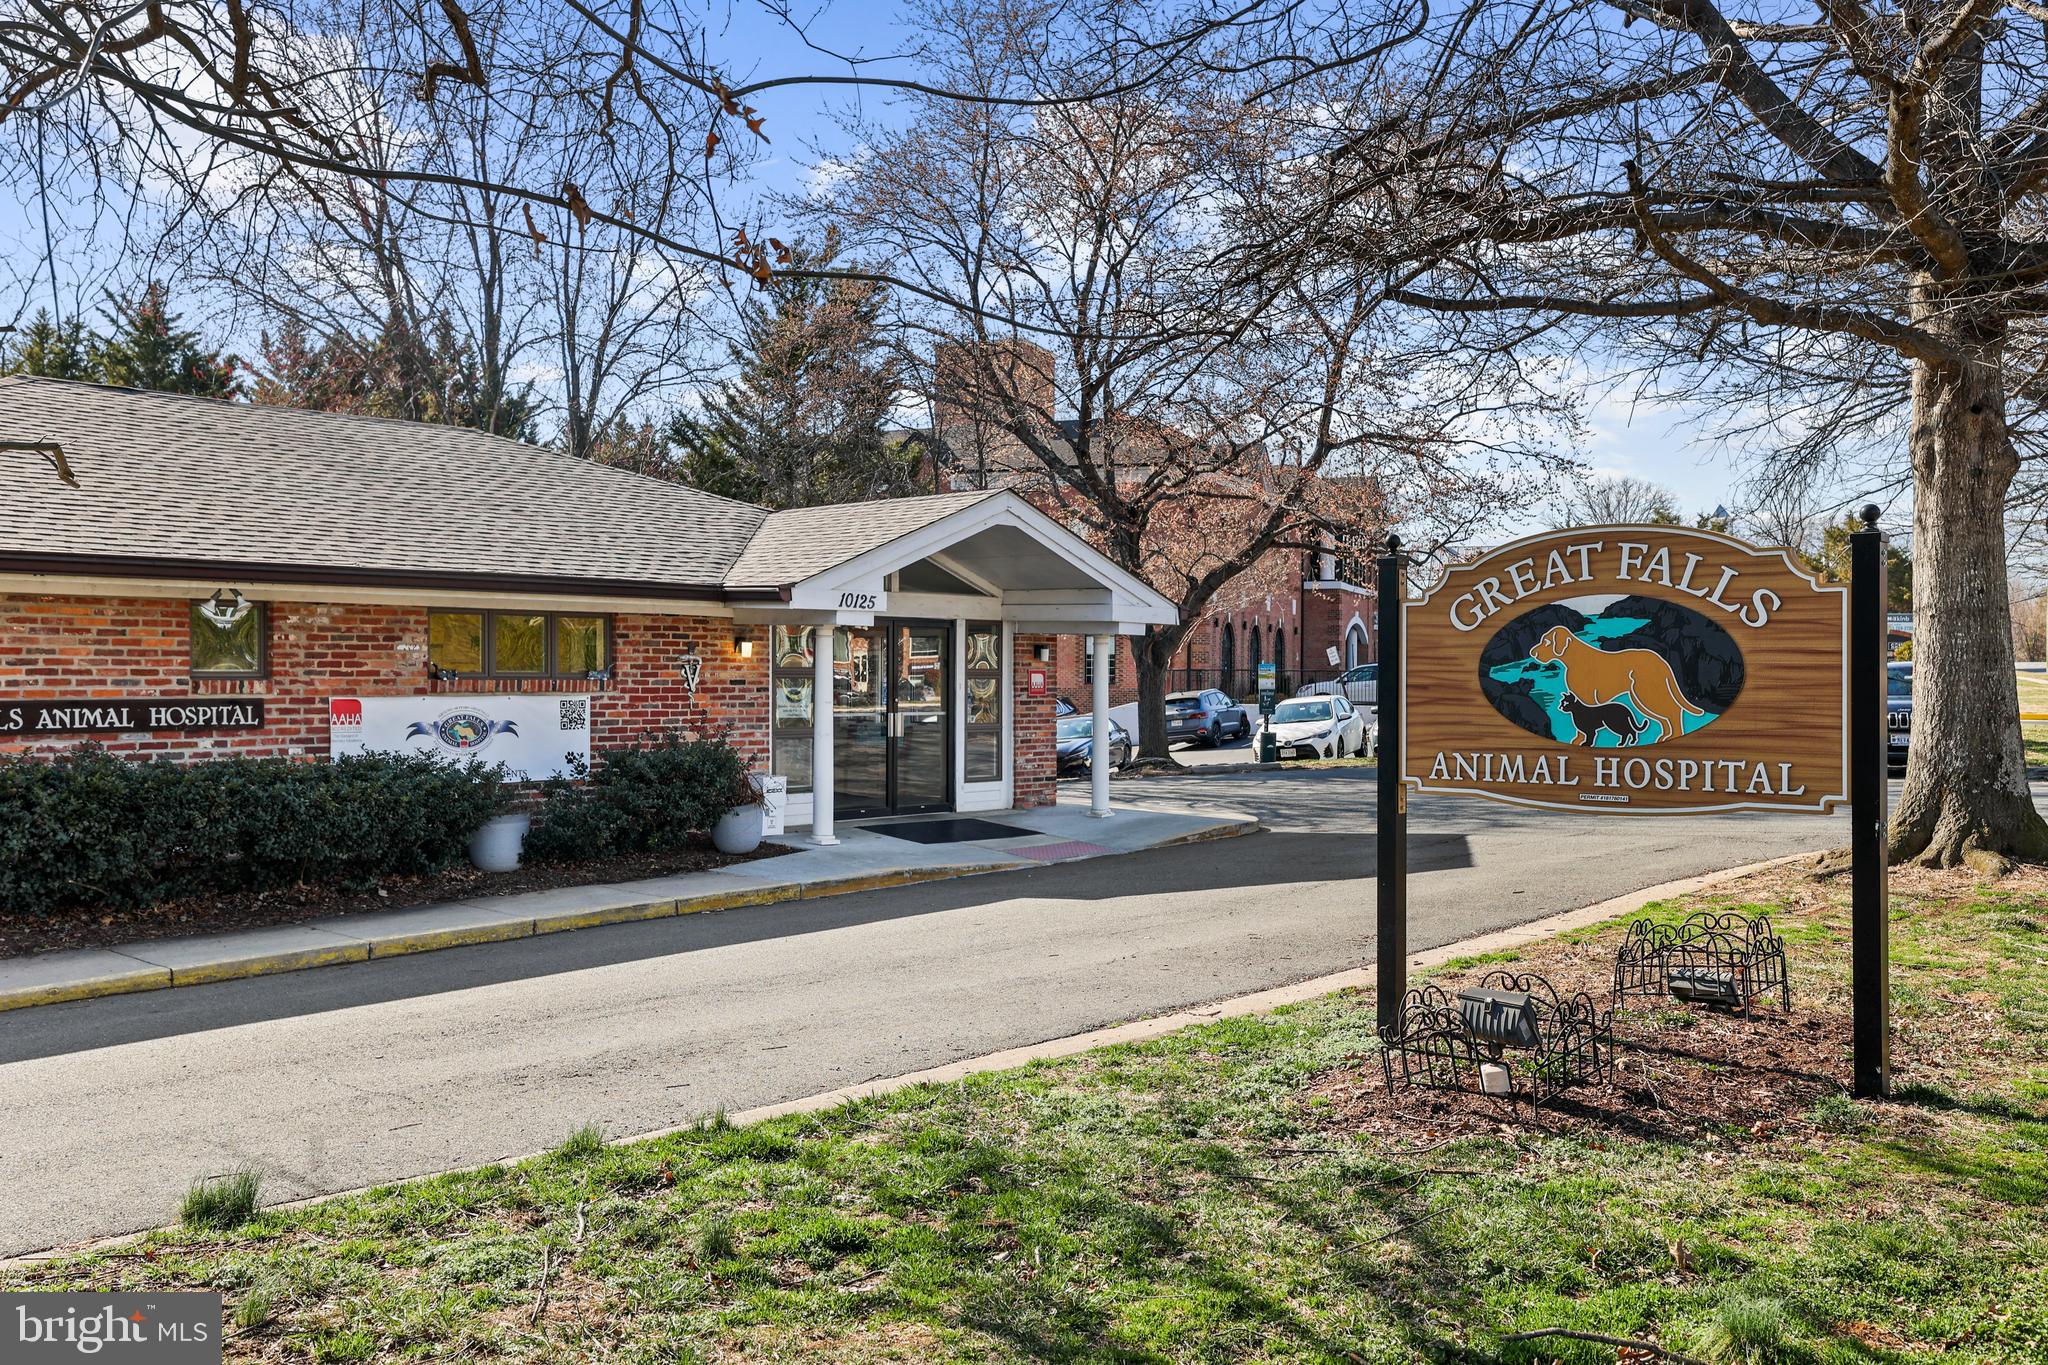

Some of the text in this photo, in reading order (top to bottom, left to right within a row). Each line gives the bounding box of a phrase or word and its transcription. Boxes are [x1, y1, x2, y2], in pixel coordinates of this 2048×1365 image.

[1448, 540, 1784, 633] GREAT FALLS
[837, 591, 878, 611] 10125
[35, 707, 135, 729] ANIMAL
[148, 705, 259, 727] HOSPITAL
[331, 713, 363, 726] AAHA
[444, 715, 484, 728] GREAT FALLS
[1428, 751, 1806, 797] ANIMAL HOSPITAL
